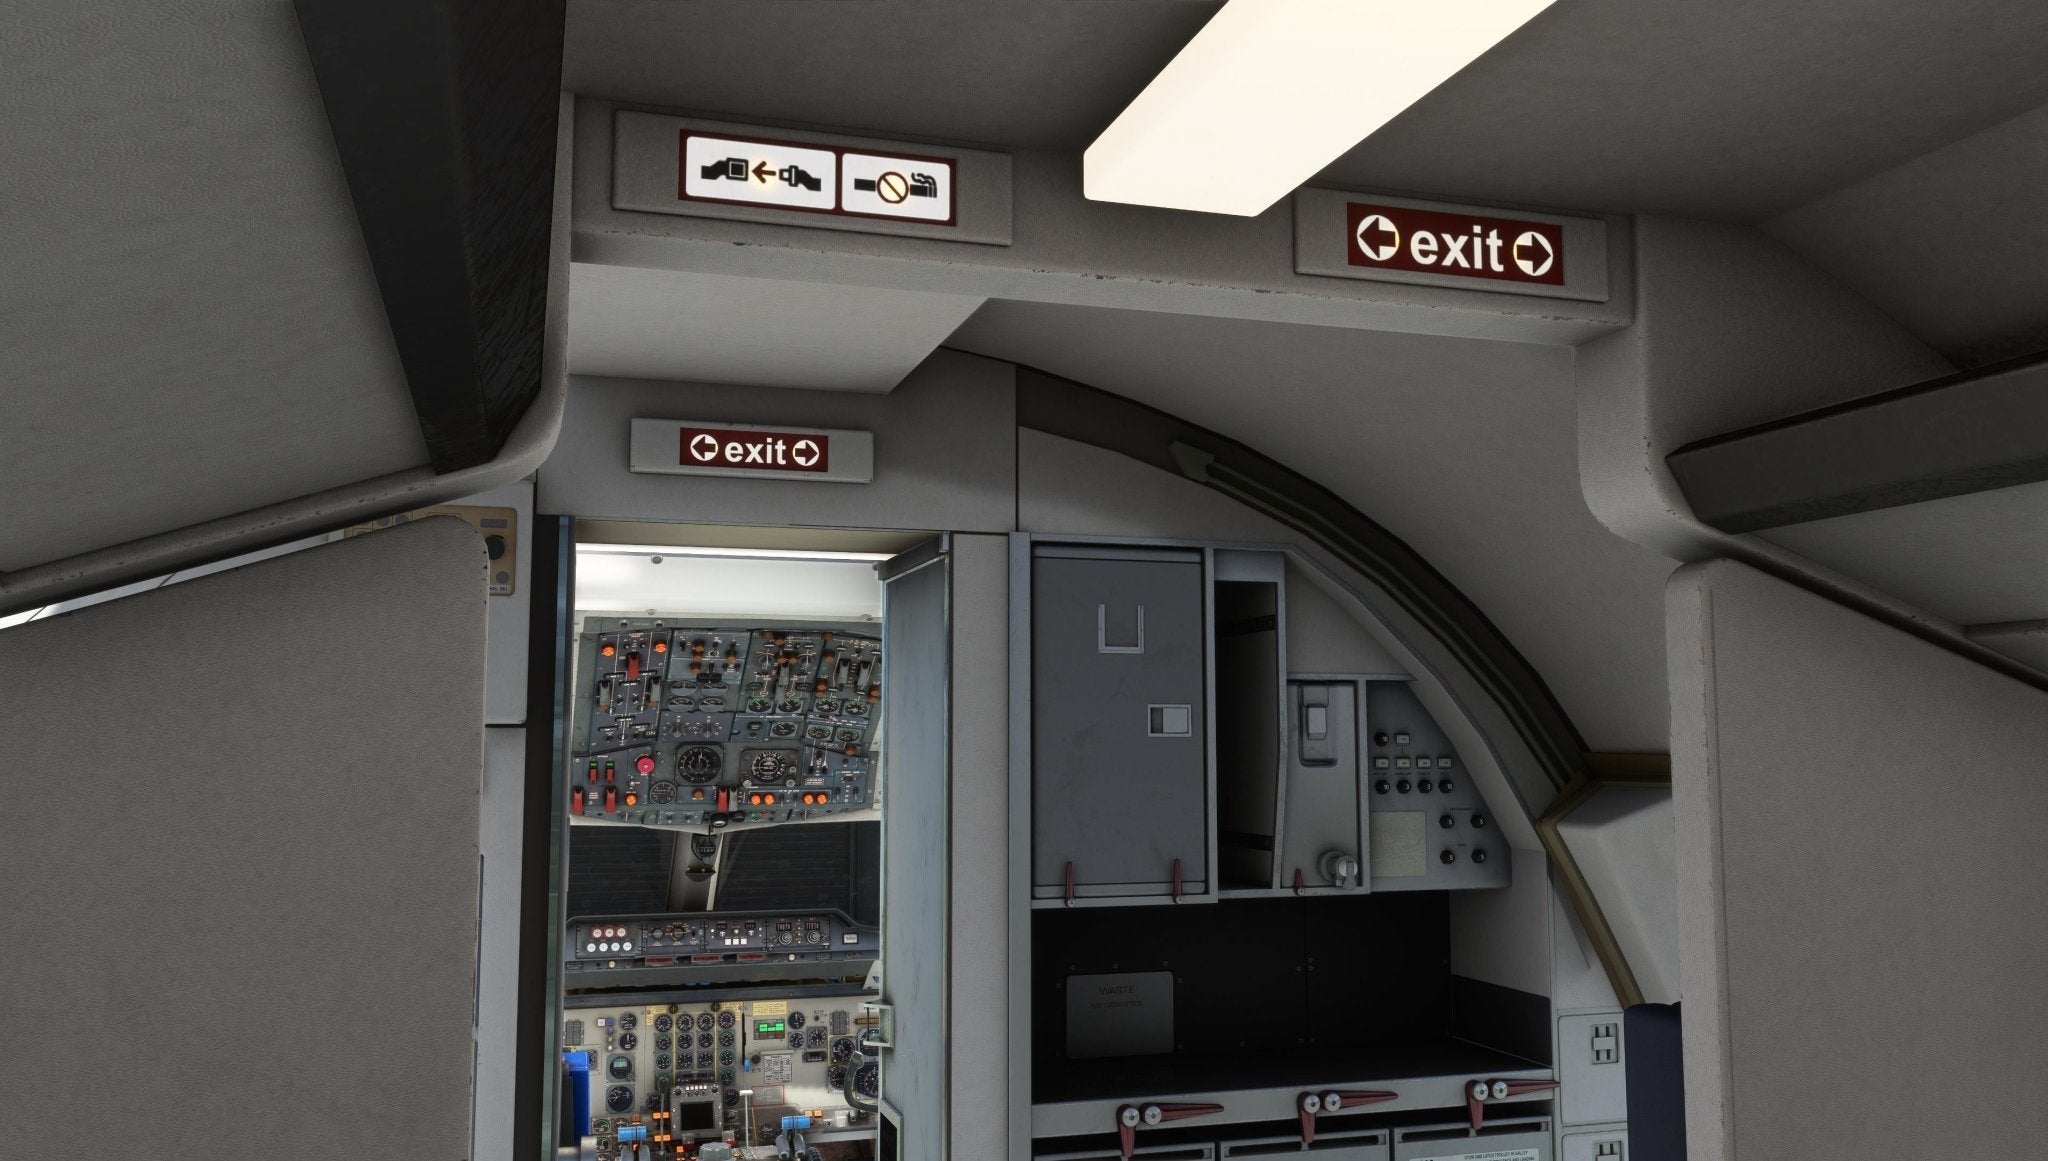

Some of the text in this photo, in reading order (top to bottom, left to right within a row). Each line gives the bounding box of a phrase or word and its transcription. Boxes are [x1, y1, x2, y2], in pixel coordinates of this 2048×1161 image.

[1410, 225, 1504, 272] exit
[725, 437, 787, 465] exit
[1099, 985, 1135, 995] WASTE
